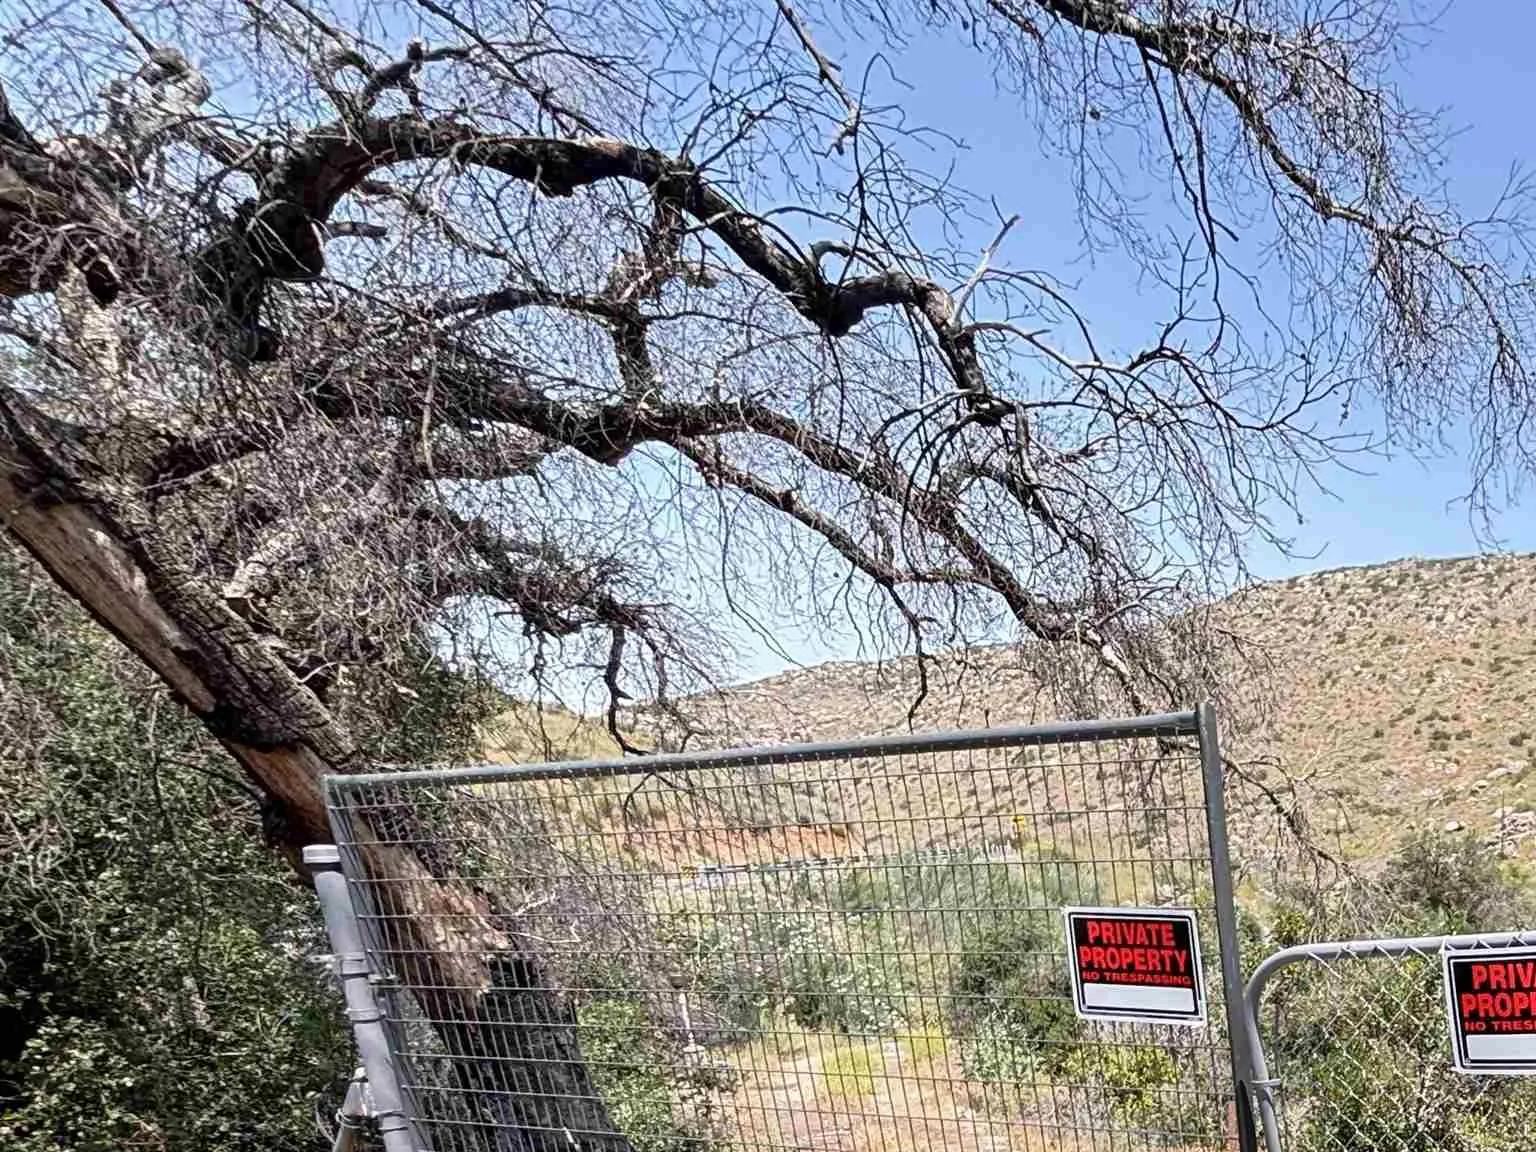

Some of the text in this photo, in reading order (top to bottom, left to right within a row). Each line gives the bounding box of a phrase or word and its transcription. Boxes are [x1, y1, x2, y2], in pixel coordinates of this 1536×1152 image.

[1087, 920, 1176, 946] PRIVATE
[1079, 946, 1187, 972] PROPERTY
[1082, 971, 1192, 985] NO TRESPASSING
[1464, 1021, 1486, 1031] NO
